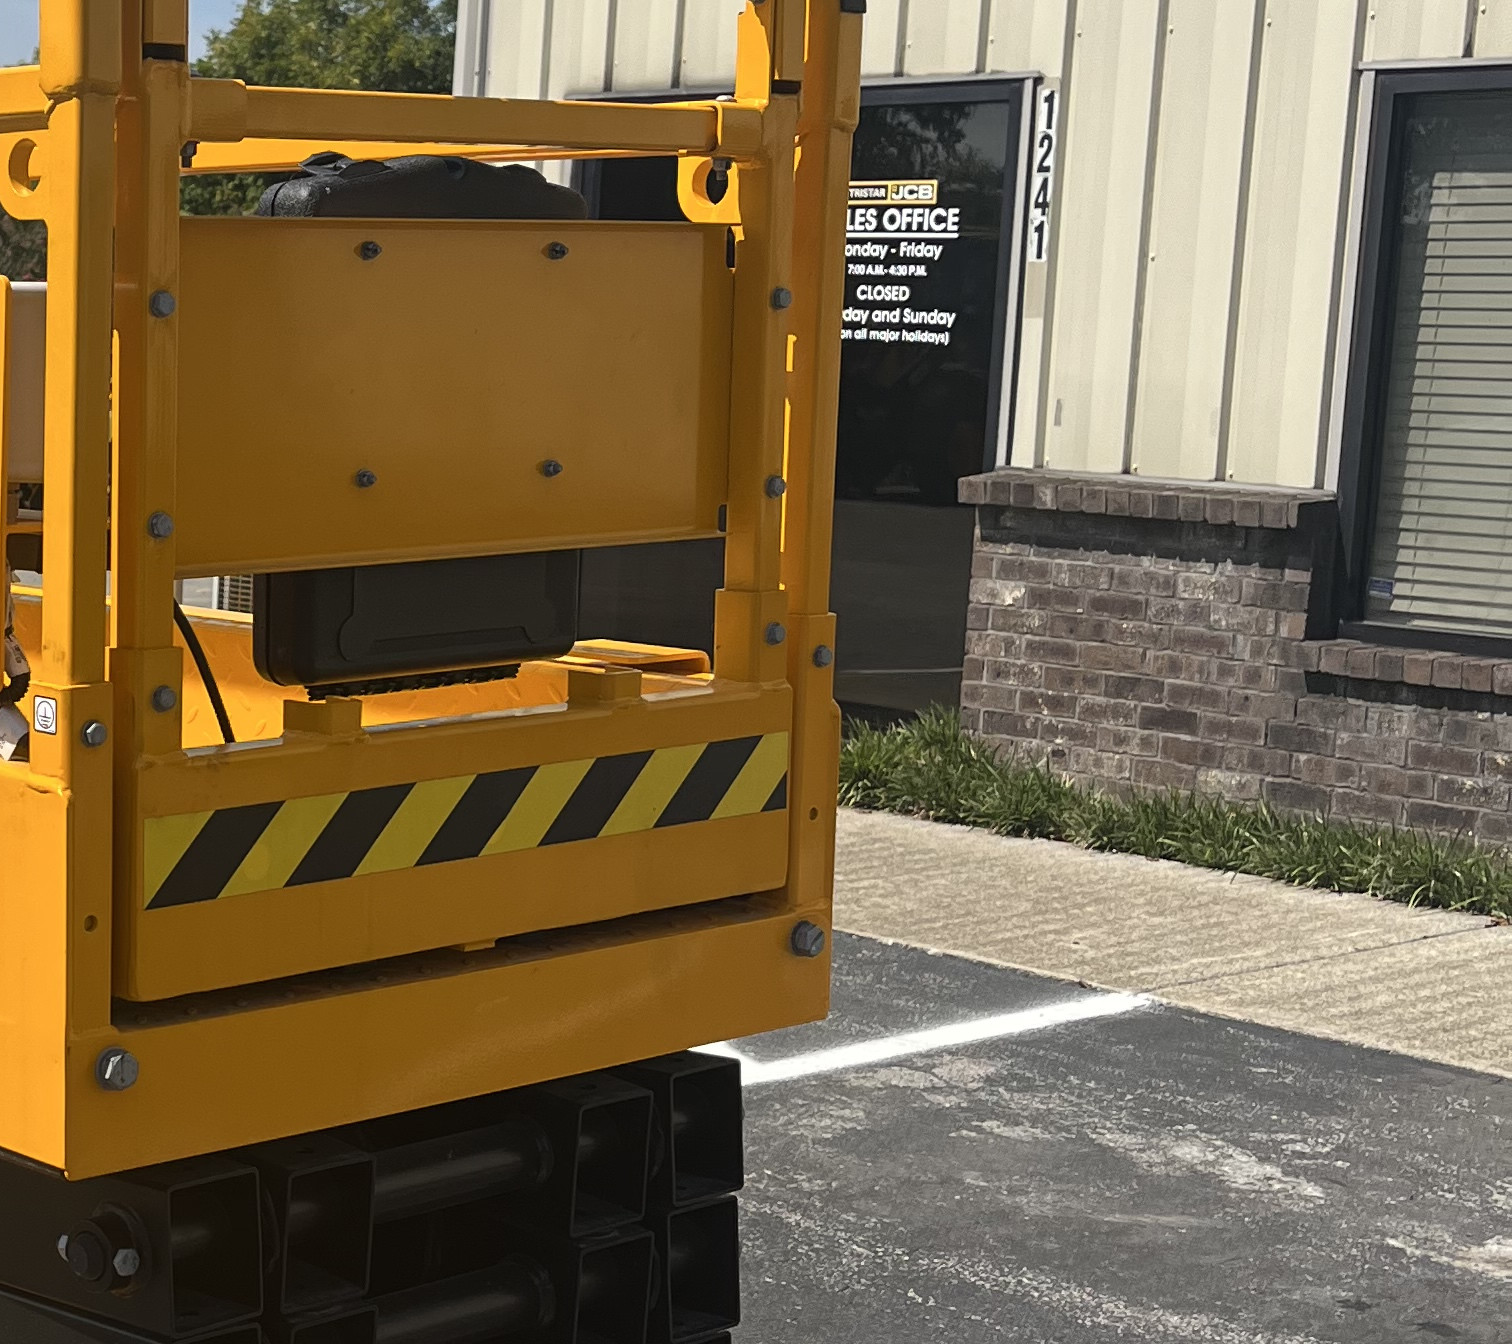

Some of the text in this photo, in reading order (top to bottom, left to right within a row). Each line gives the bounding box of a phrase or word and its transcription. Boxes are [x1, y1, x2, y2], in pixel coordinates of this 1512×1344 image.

[1033, 89, 1057, 260] 1241
[849, 184, 933, 200] TRISTAR JCB
[846, 208, 960, 232] LES OFFICE
[844, 241, 888, 260] onday
[899, 241, 943, 261] Friday
[856, 284, 910, 301] CLOSED
[872, 308, 900, 323] and
[902, 308, 956, 328] Sunday
[869, 328, 900, 342] major
